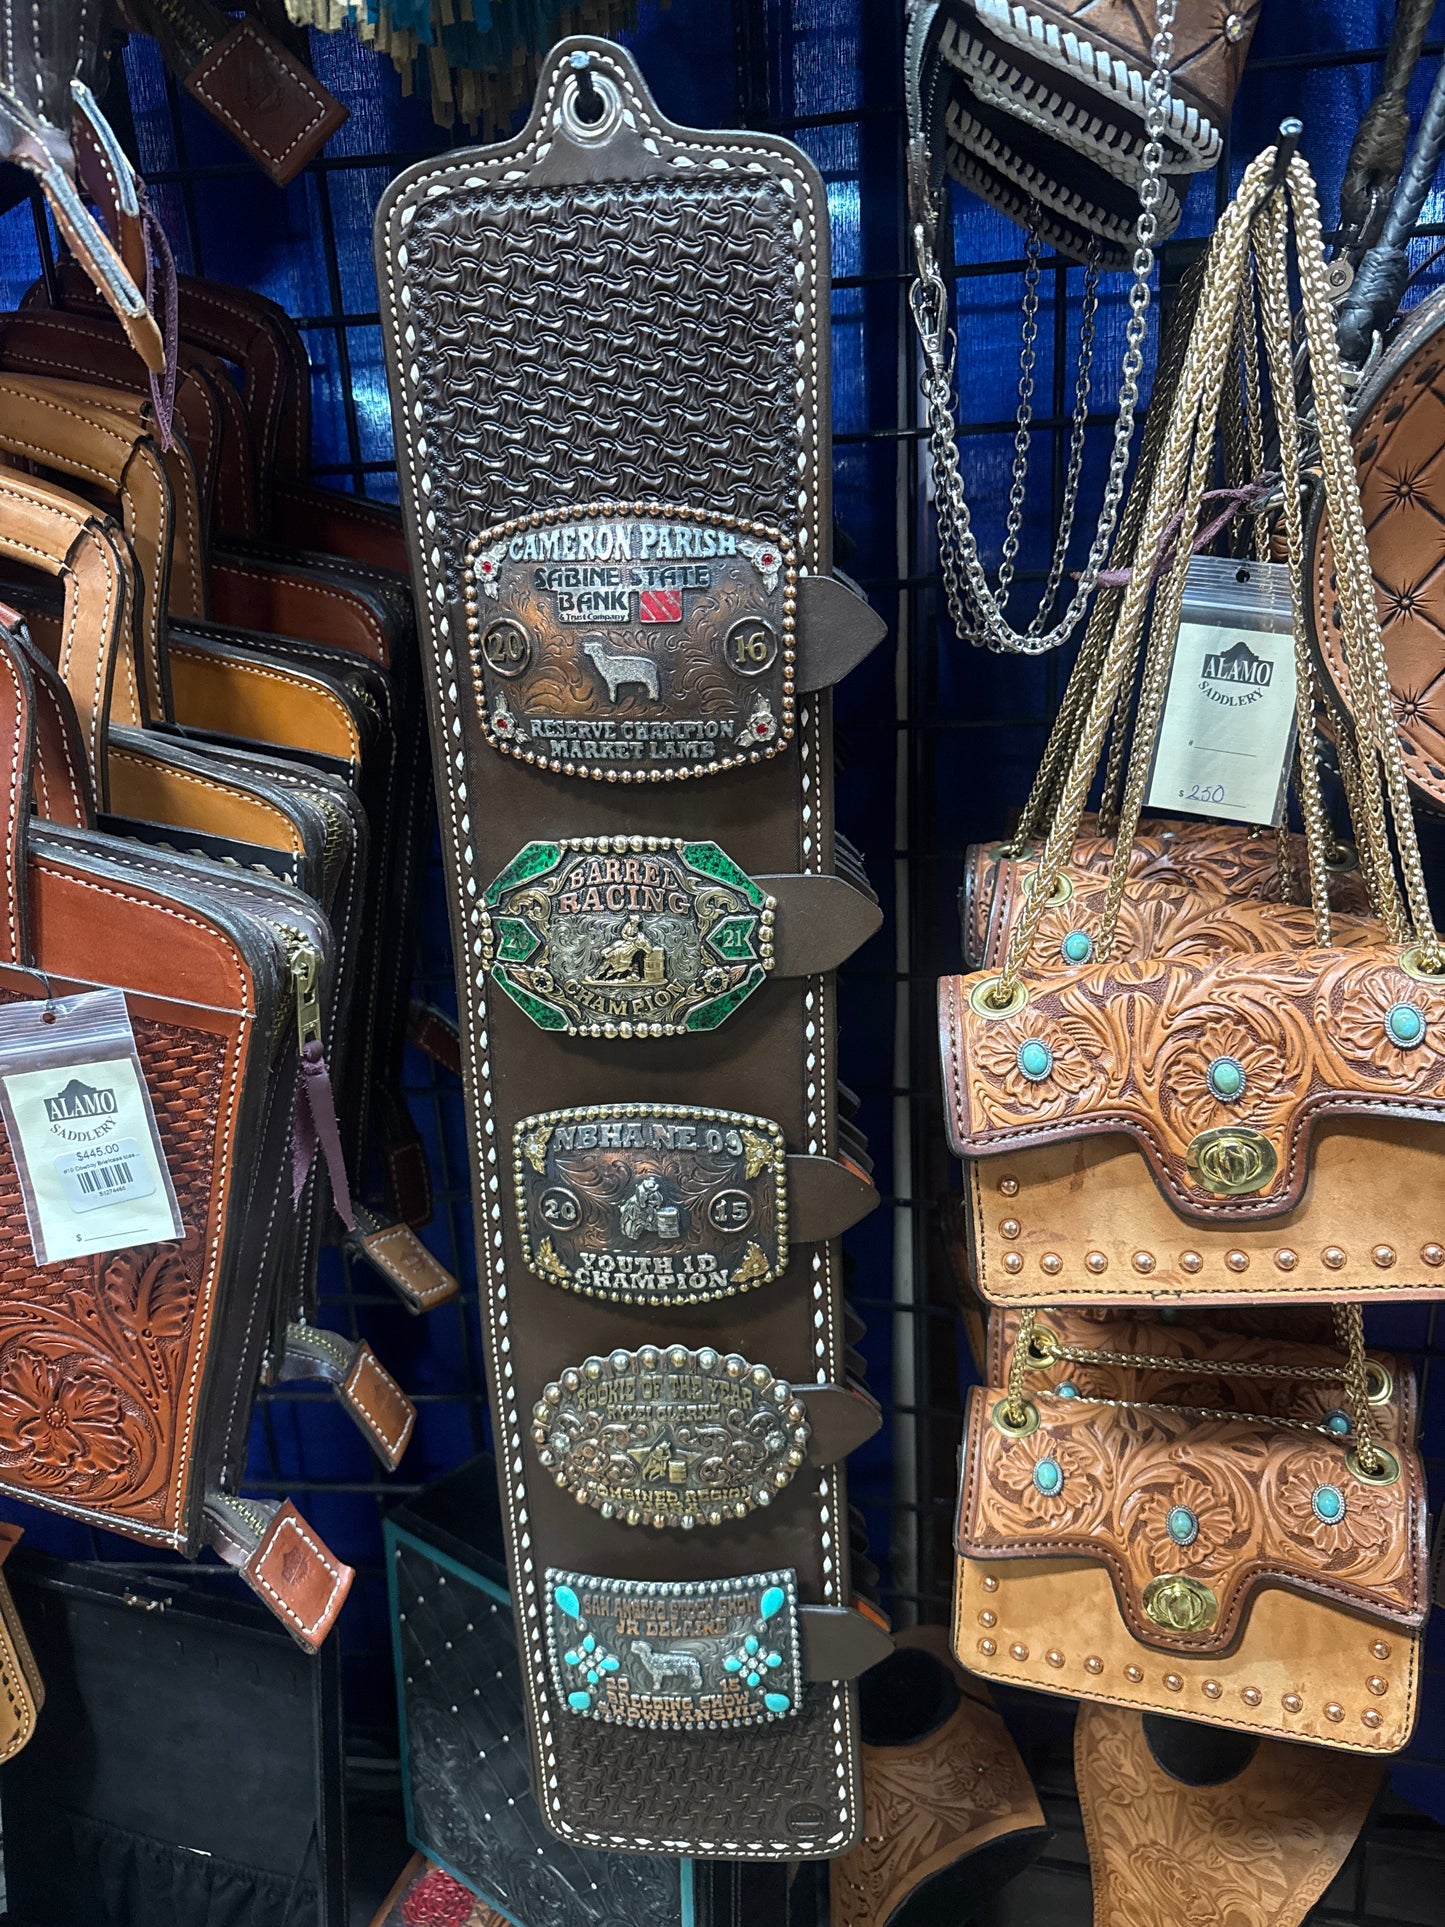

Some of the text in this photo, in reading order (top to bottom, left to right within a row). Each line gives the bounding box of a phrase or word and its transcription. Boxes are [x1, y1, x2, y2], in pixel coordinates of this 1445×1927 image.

[508, 525, 738, 563] CAMERON PARISH
[533, 565, 711, 589] SABINE STATE
[558, 591, 629, 613] BANK
[566, 613, 586, 621] Trust
[587, 613, 626, 622] Company
[488, 632, 524, 662] 20
[735, 631, 768, 664] 16
[1203, 656, 1272, 685] ALAMO
[1198, 680, 1265, 707] SADDLERY
[530, 719, 735, 742] RESERVE CHAMPION
[550, 741, 717, 760] MARKET LAMB
[569, 858, 678, 890] BARREL
[558, 884, 691, 914] RACING
[722, 929, 743, 949] 21
[564, 978, 686, 1016] CHAMPION
[50, 1090, 116, 1121] ALAMO
[50, 1115, 118, 1142] SADDLERY
[76, 1143, 120, 1162] $445.00
[544, 1198, 577, 1221] 20
[714, 1199, 749, 1222] 15
[579, 1253, 673, 1274] YOUTH
[575, 1267, 729, 1290] CHAMPION
[576, 1374, 753, 1411] ROOKIE OF THE YEAR
[586, 1481, 754, 1503] COMBINED REGION
[616, 1620, 640, 1635] JR
[719, 1678, 740, 1693] 15
[606, 1692, 750, 1710] BREEDING SHOW
